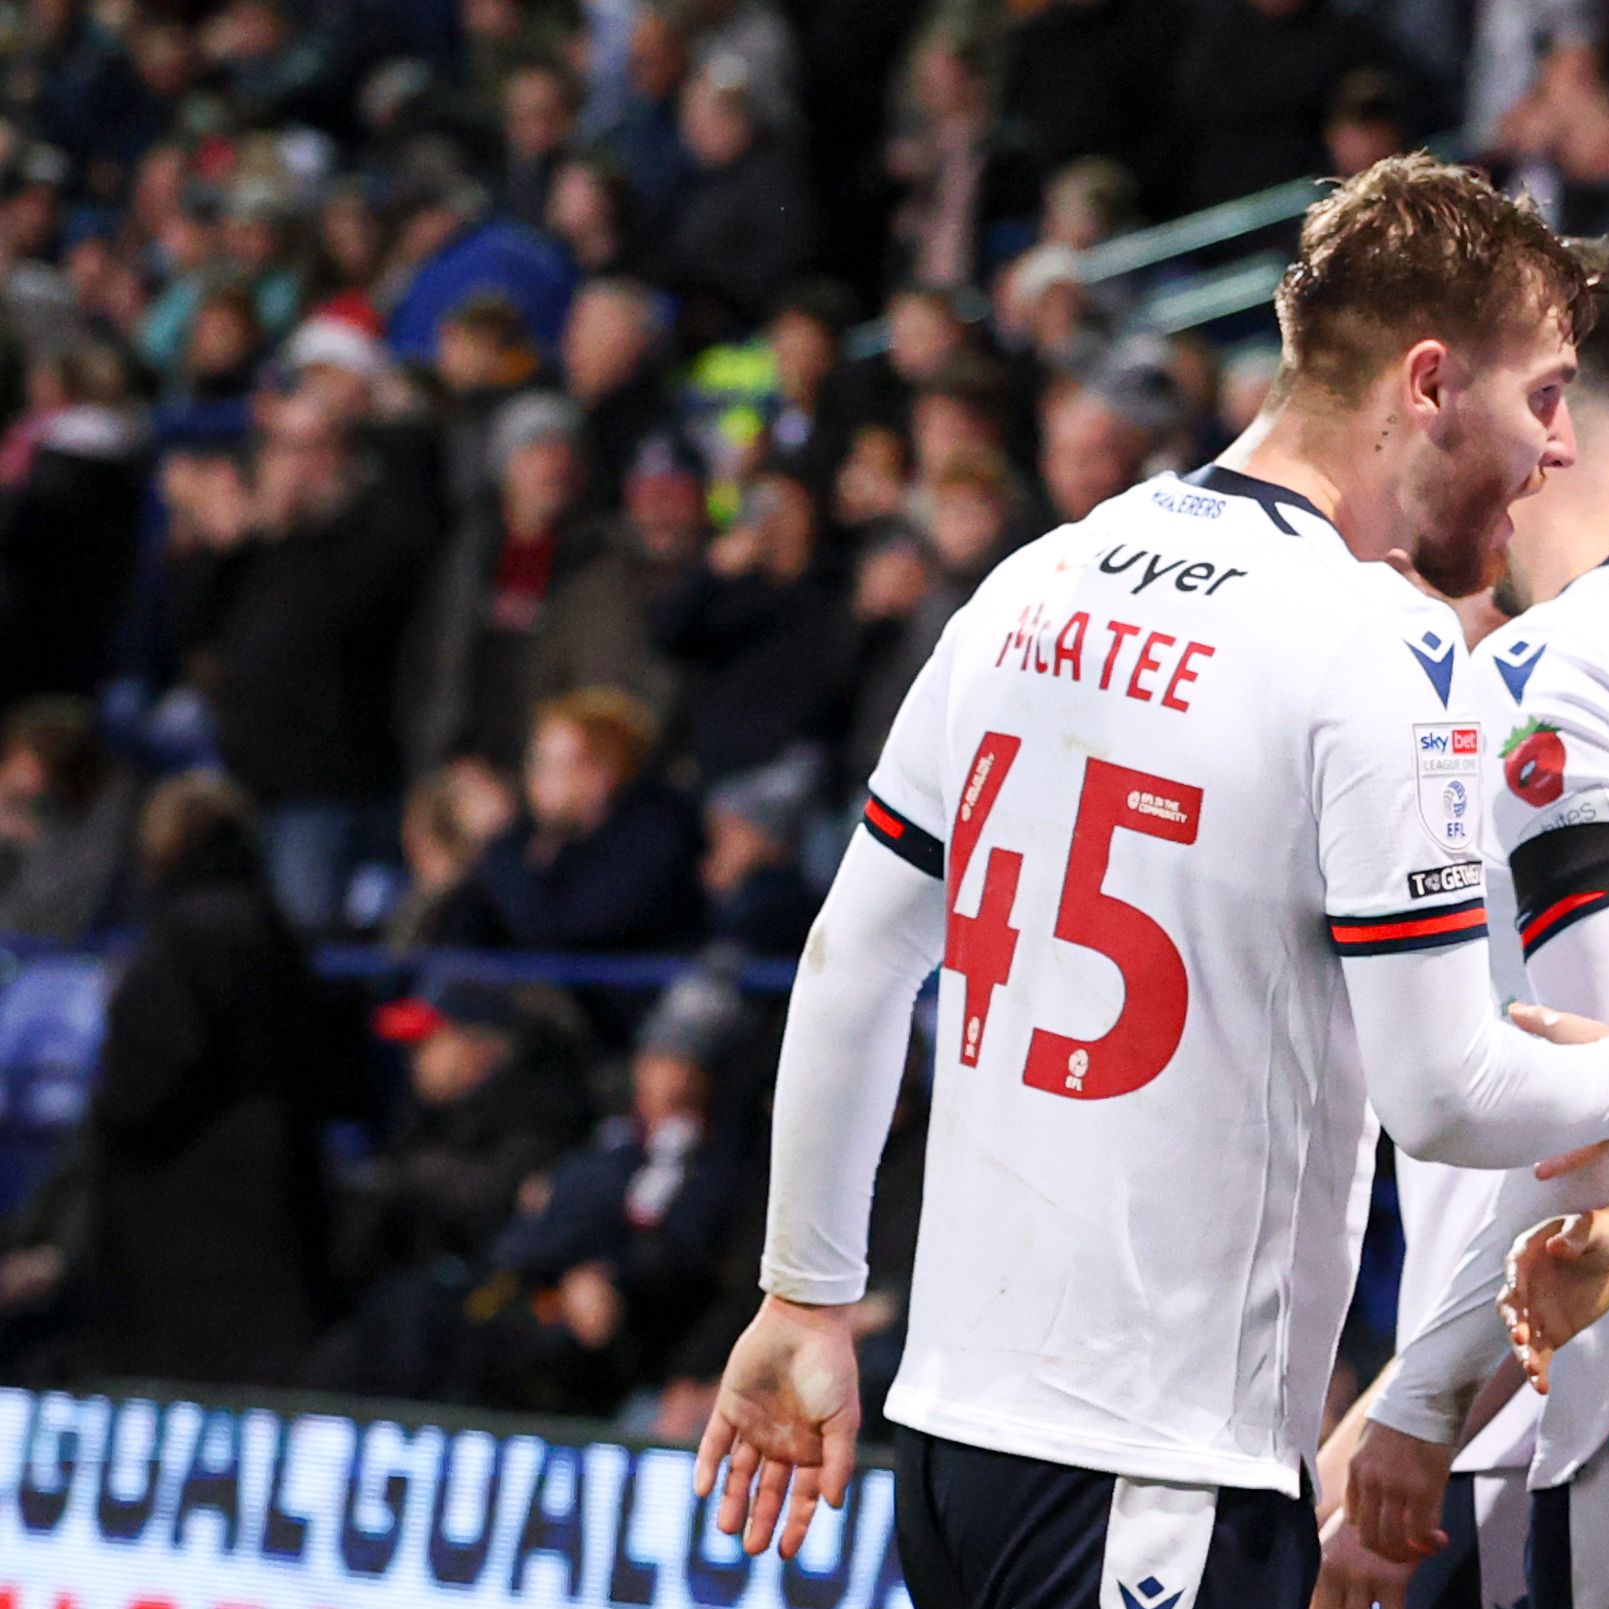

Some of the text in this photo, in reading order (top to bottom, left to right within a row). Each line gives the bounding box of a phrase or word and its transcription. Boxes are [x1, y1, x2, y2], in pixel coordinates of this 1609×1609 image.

[1420, 731, 1477, 753] sky bet
[1446, 823, 1467, 838] EFL
[945, 731, 1204, 1101] 45
